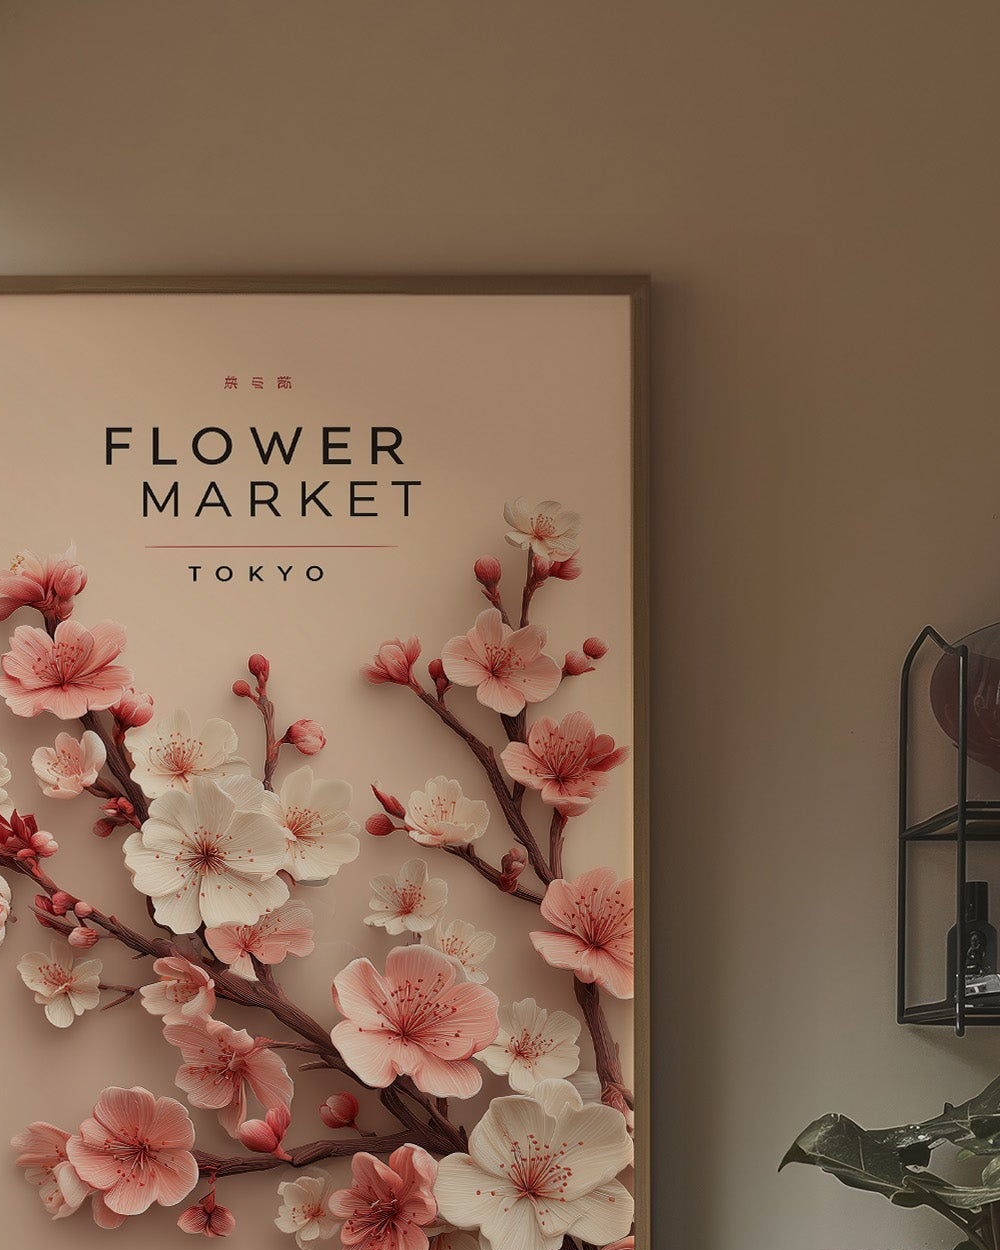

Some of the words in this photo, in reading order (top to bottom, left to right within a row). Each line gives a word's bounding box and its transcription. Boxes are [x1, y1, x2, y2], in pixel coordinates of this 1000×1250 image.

[105, 426, 405, 465] FLOWER
[142, 480, 422, 517] MARKET
[188, 565, 324, 582] TOKYO
